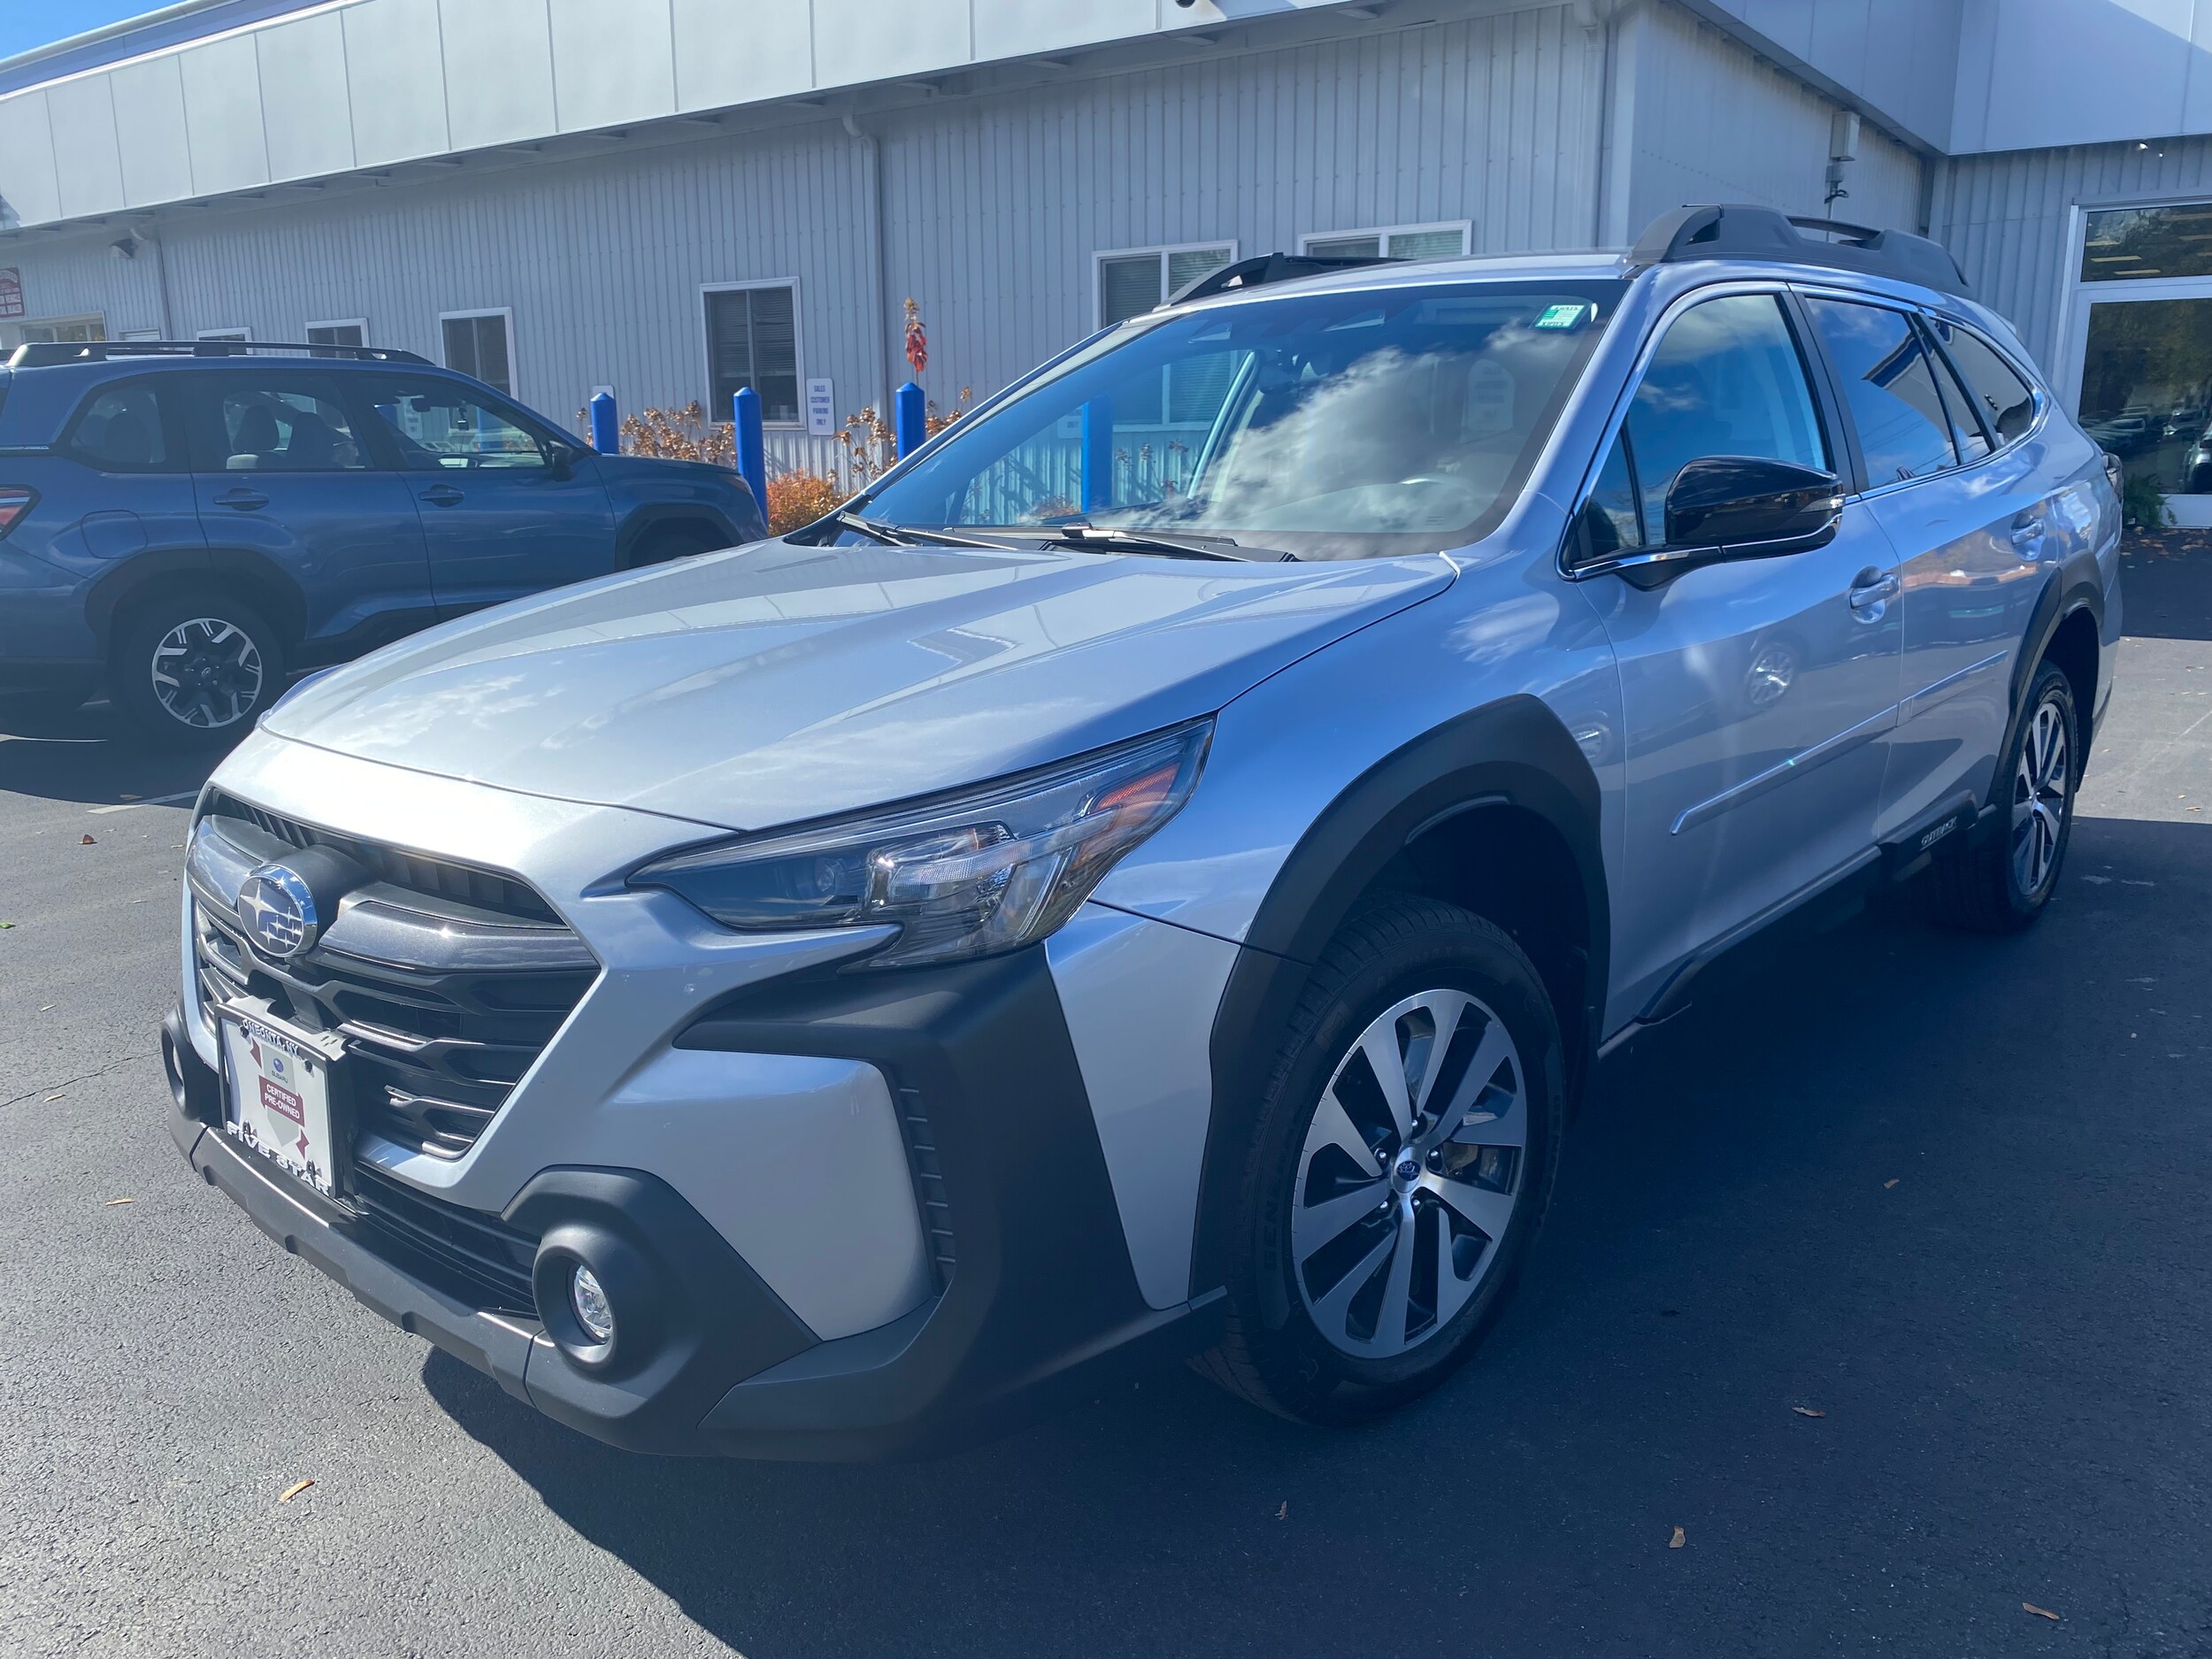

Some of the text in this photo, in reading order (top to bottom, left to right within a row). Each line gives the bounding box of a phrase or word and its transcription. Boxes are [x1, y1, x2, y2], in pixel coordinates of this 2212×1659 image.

[285, 1041, 299, 1056] NY
[272, 1071, 288, 1083] SUBARU
[265, 1093, 300, 1119] PRE-OWNED
[266, 1084, 296, 1107] CERTIFIED
[227, 1121, 329, 1195] FIVE STAR
